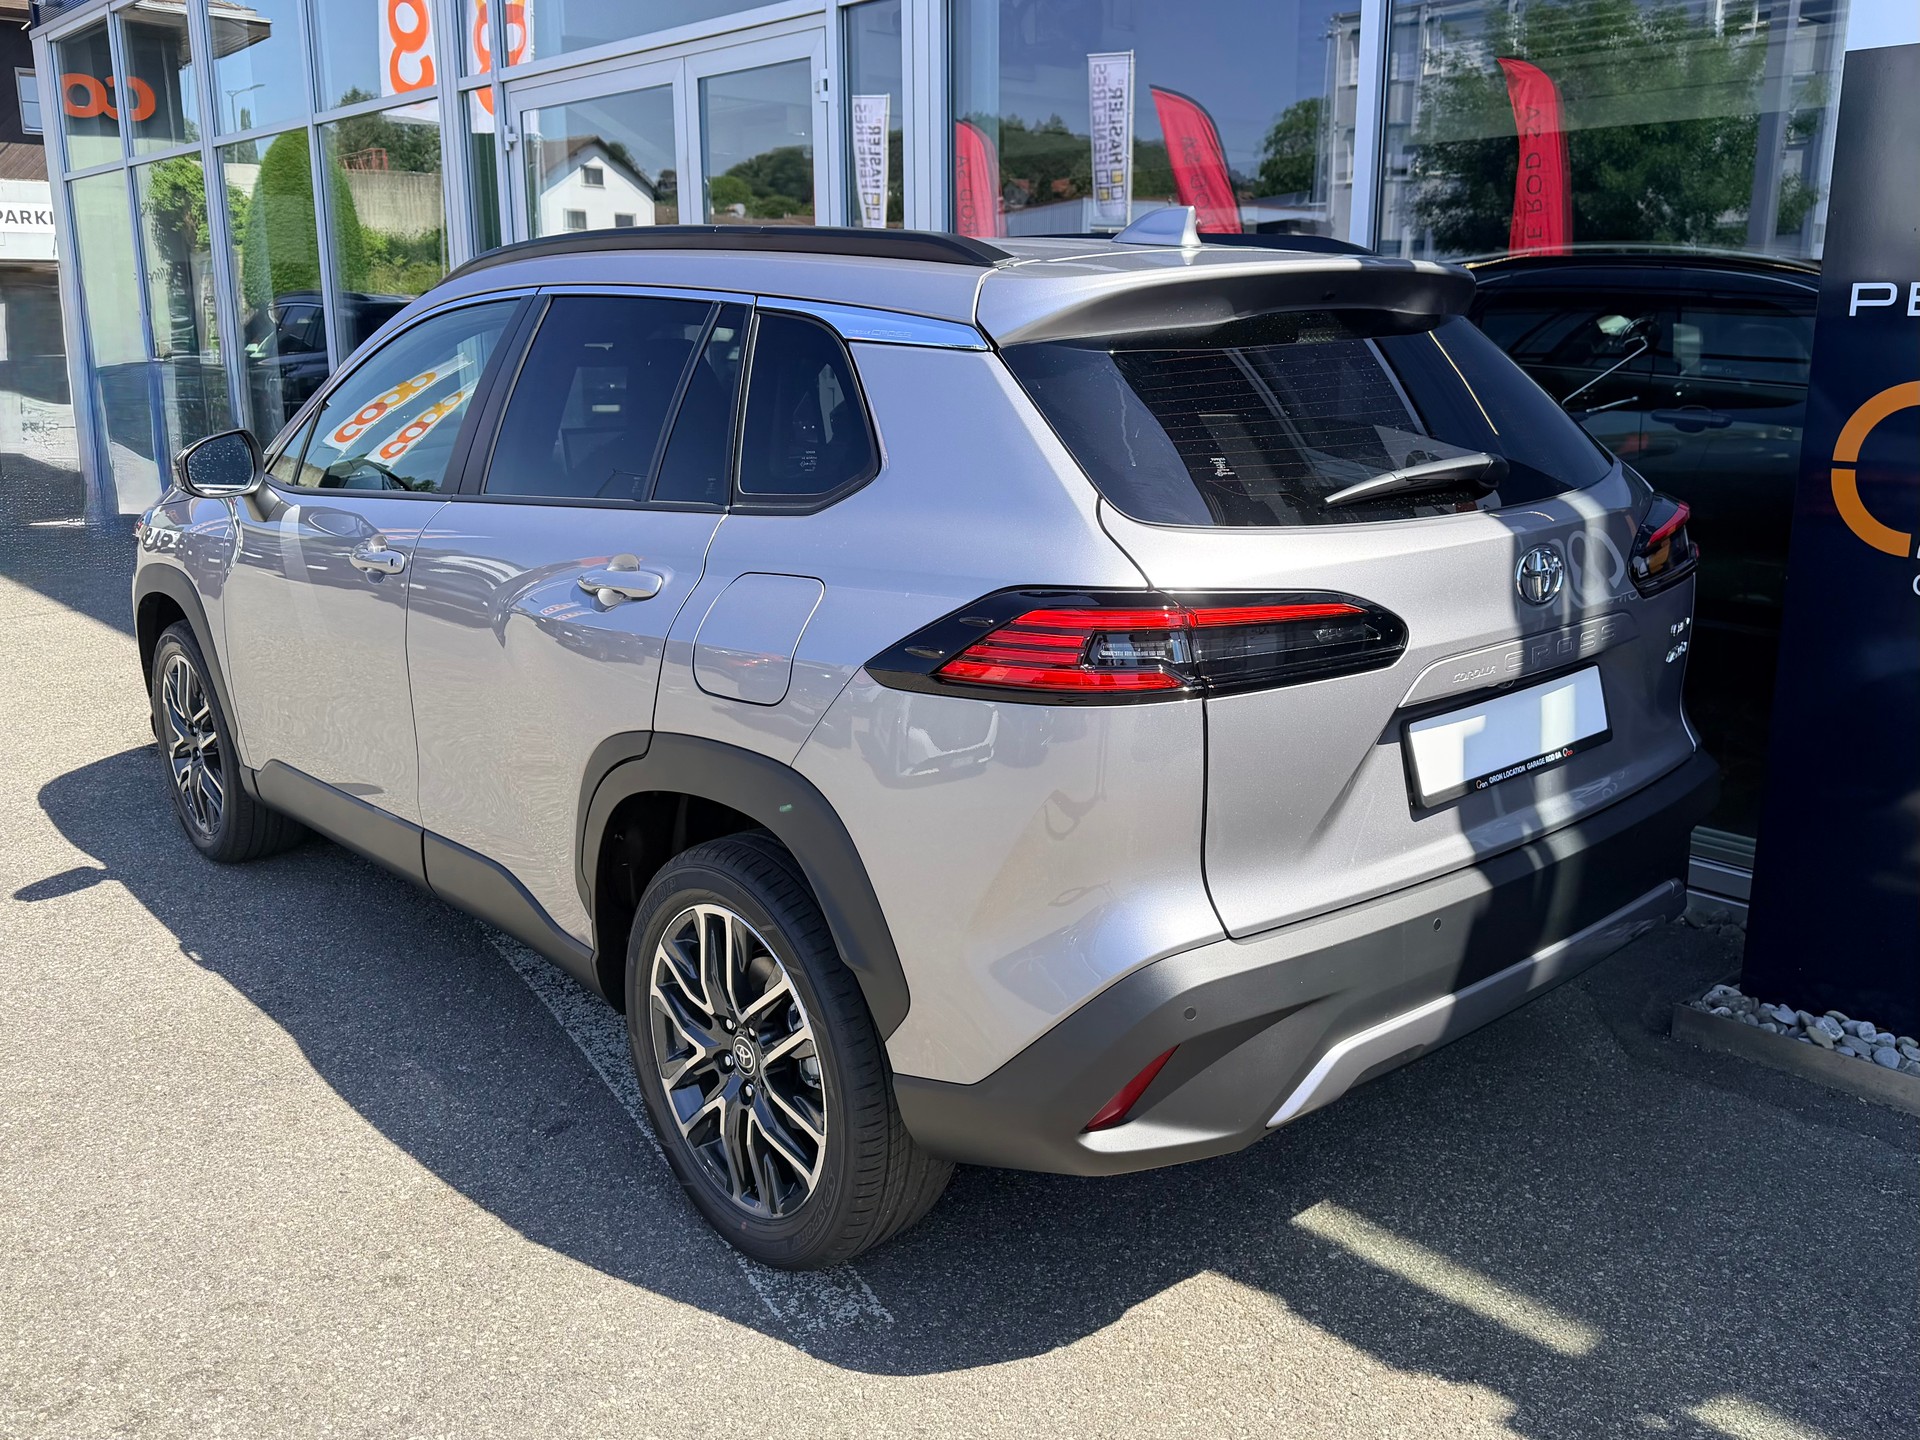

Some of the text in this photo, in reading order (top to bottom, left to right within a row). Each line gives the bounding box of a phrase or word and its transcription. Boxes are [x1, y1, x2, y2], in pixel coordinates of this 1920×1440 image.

[0, 209, 54, 225] ARKI
[1504, 622, 1616, 673] CROSS
[1503, 764, 1526, 779] LOCATION
[1526, 757, 1546, 770] GARAGE
